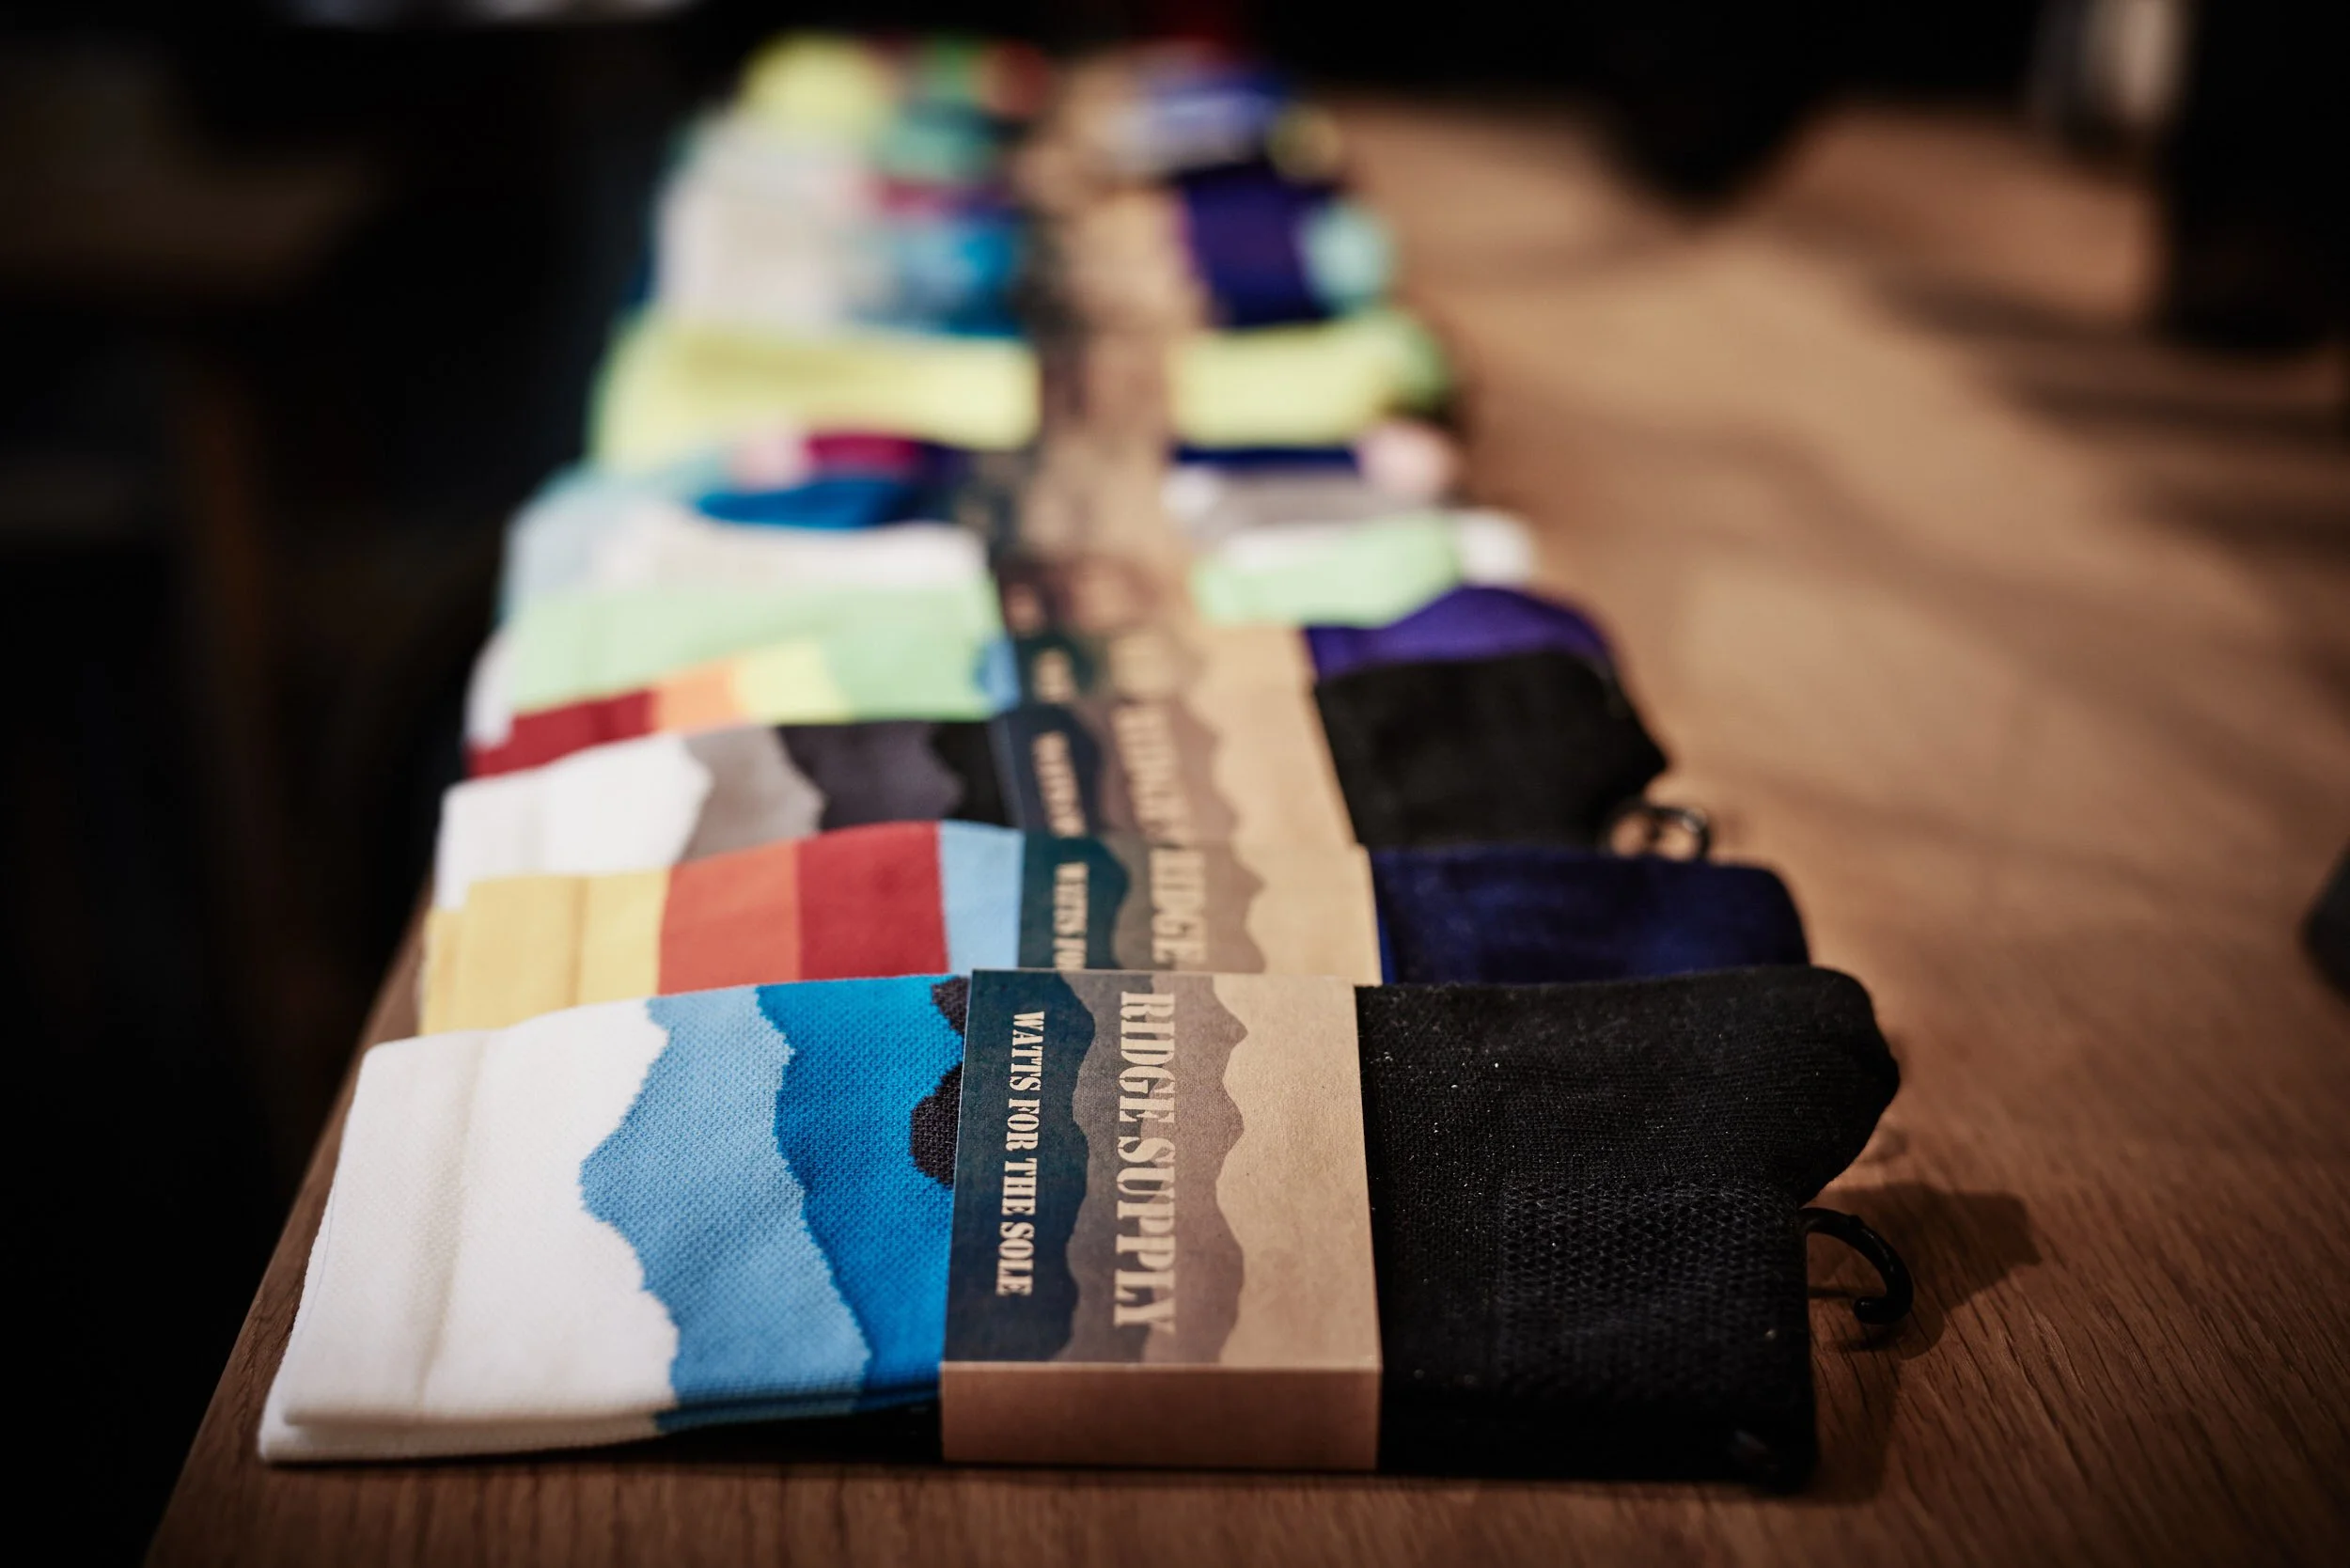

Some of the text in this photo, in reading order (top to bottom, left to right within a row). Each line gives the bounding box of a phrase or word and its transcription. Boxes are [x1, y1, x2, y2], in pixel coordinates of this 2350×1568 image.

[1151, 851, 1207, 963] RIDGE
[995, 1011, 1045, 1297] WATTS FOR THE SOLE
[1114, 991, 1176, 1333] RIDGE SUPPLY
